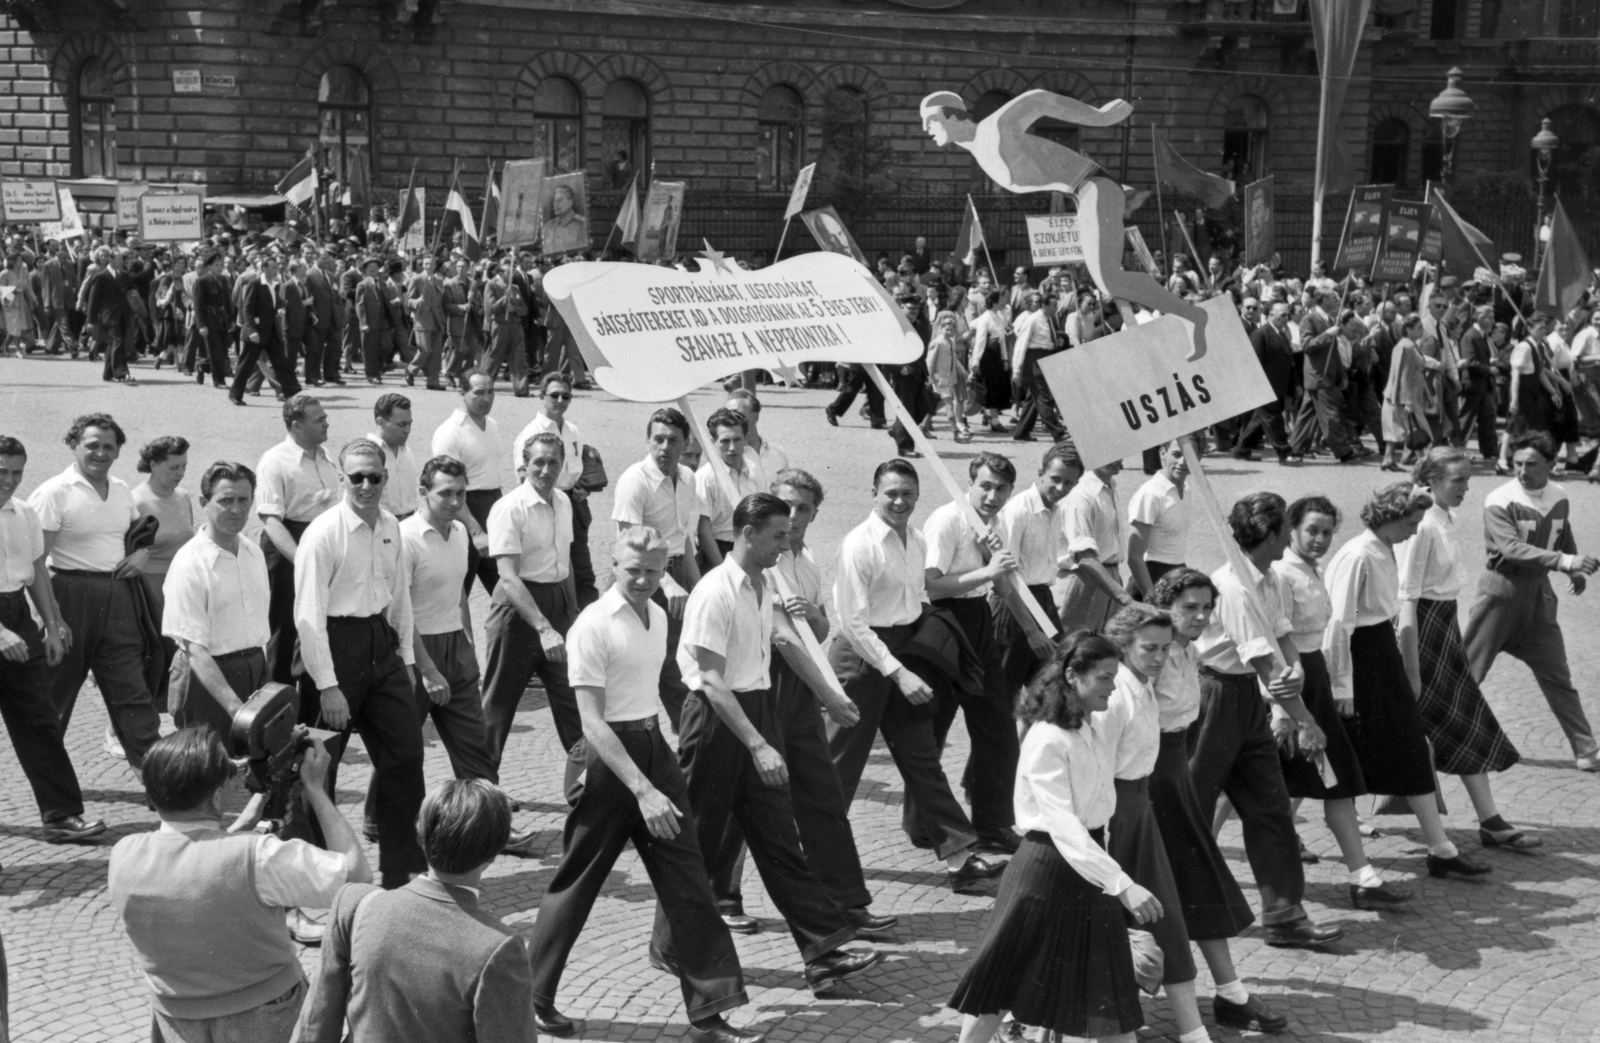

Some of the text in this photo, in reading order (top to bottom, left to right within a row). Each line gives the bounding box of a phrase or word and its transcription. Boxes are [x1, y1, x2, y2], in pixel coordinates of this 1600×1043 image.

[1048, 215, 1075, 229] ÉLJEN
[1033, 230, 1080, 245] SZOVJETU
[1039, 246, 1058, 257] BÉKE
[647, 280, 748, 306] SPORTPÁLYÁKAT,
[592, 308, 692, 336] JÁTSZÓTEREKET
[689, 308, 709, 328] AD
[708, 307, 723, 326] A
[717, 300, 801, 325] DOLGOZÓKNAK
[796, 301, 815, 319] AZ
[808, 297, 825, 318] 5
[846, 295, 883, 314] TERV!
[675, 332, 743, 363] SZAVAZZ
[741, 330, 760, 356] A
[1120, 372, 1211, 430] USZÁS
